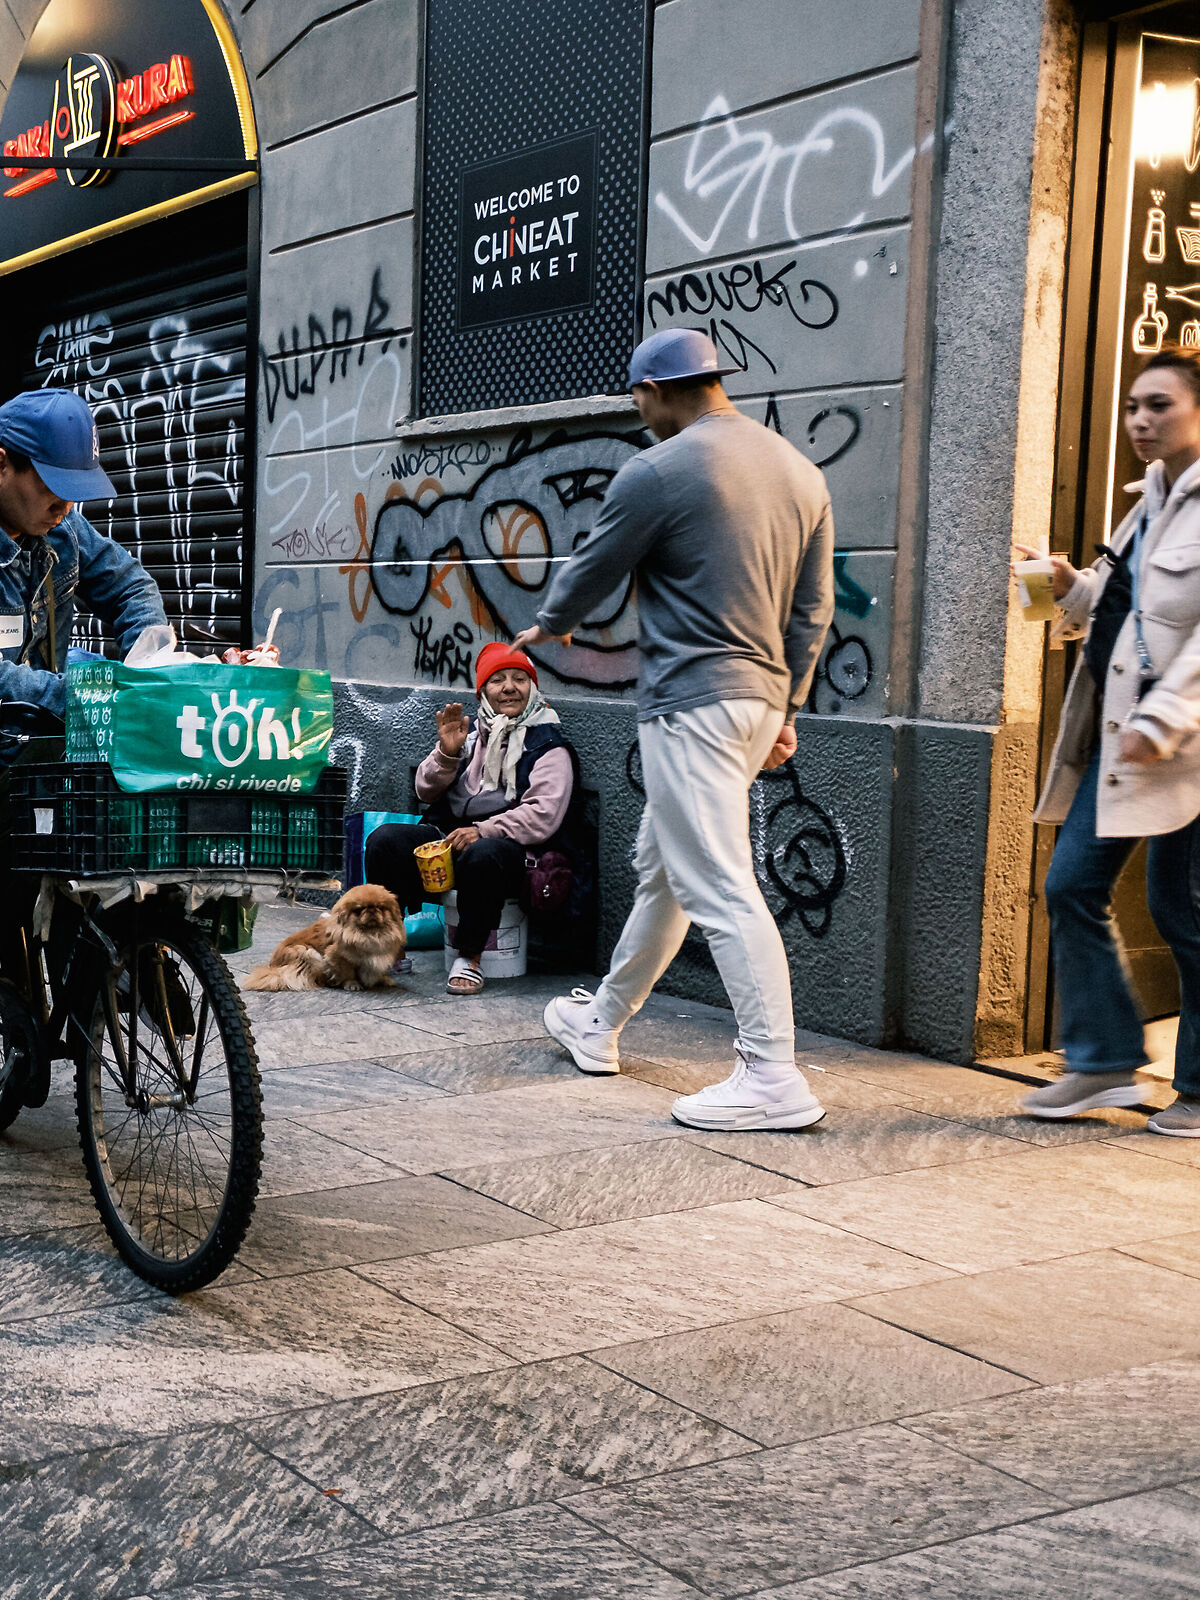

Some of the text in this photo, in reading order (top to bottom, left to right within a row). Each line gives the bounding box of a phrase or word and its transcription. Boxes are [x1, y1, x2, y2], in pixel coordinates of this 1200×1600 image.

[474, 174, 580, 220] WELCOME TO
[472, 252, 578, 294] MARKET
[176, 772, 302, 793] chi si rivede
